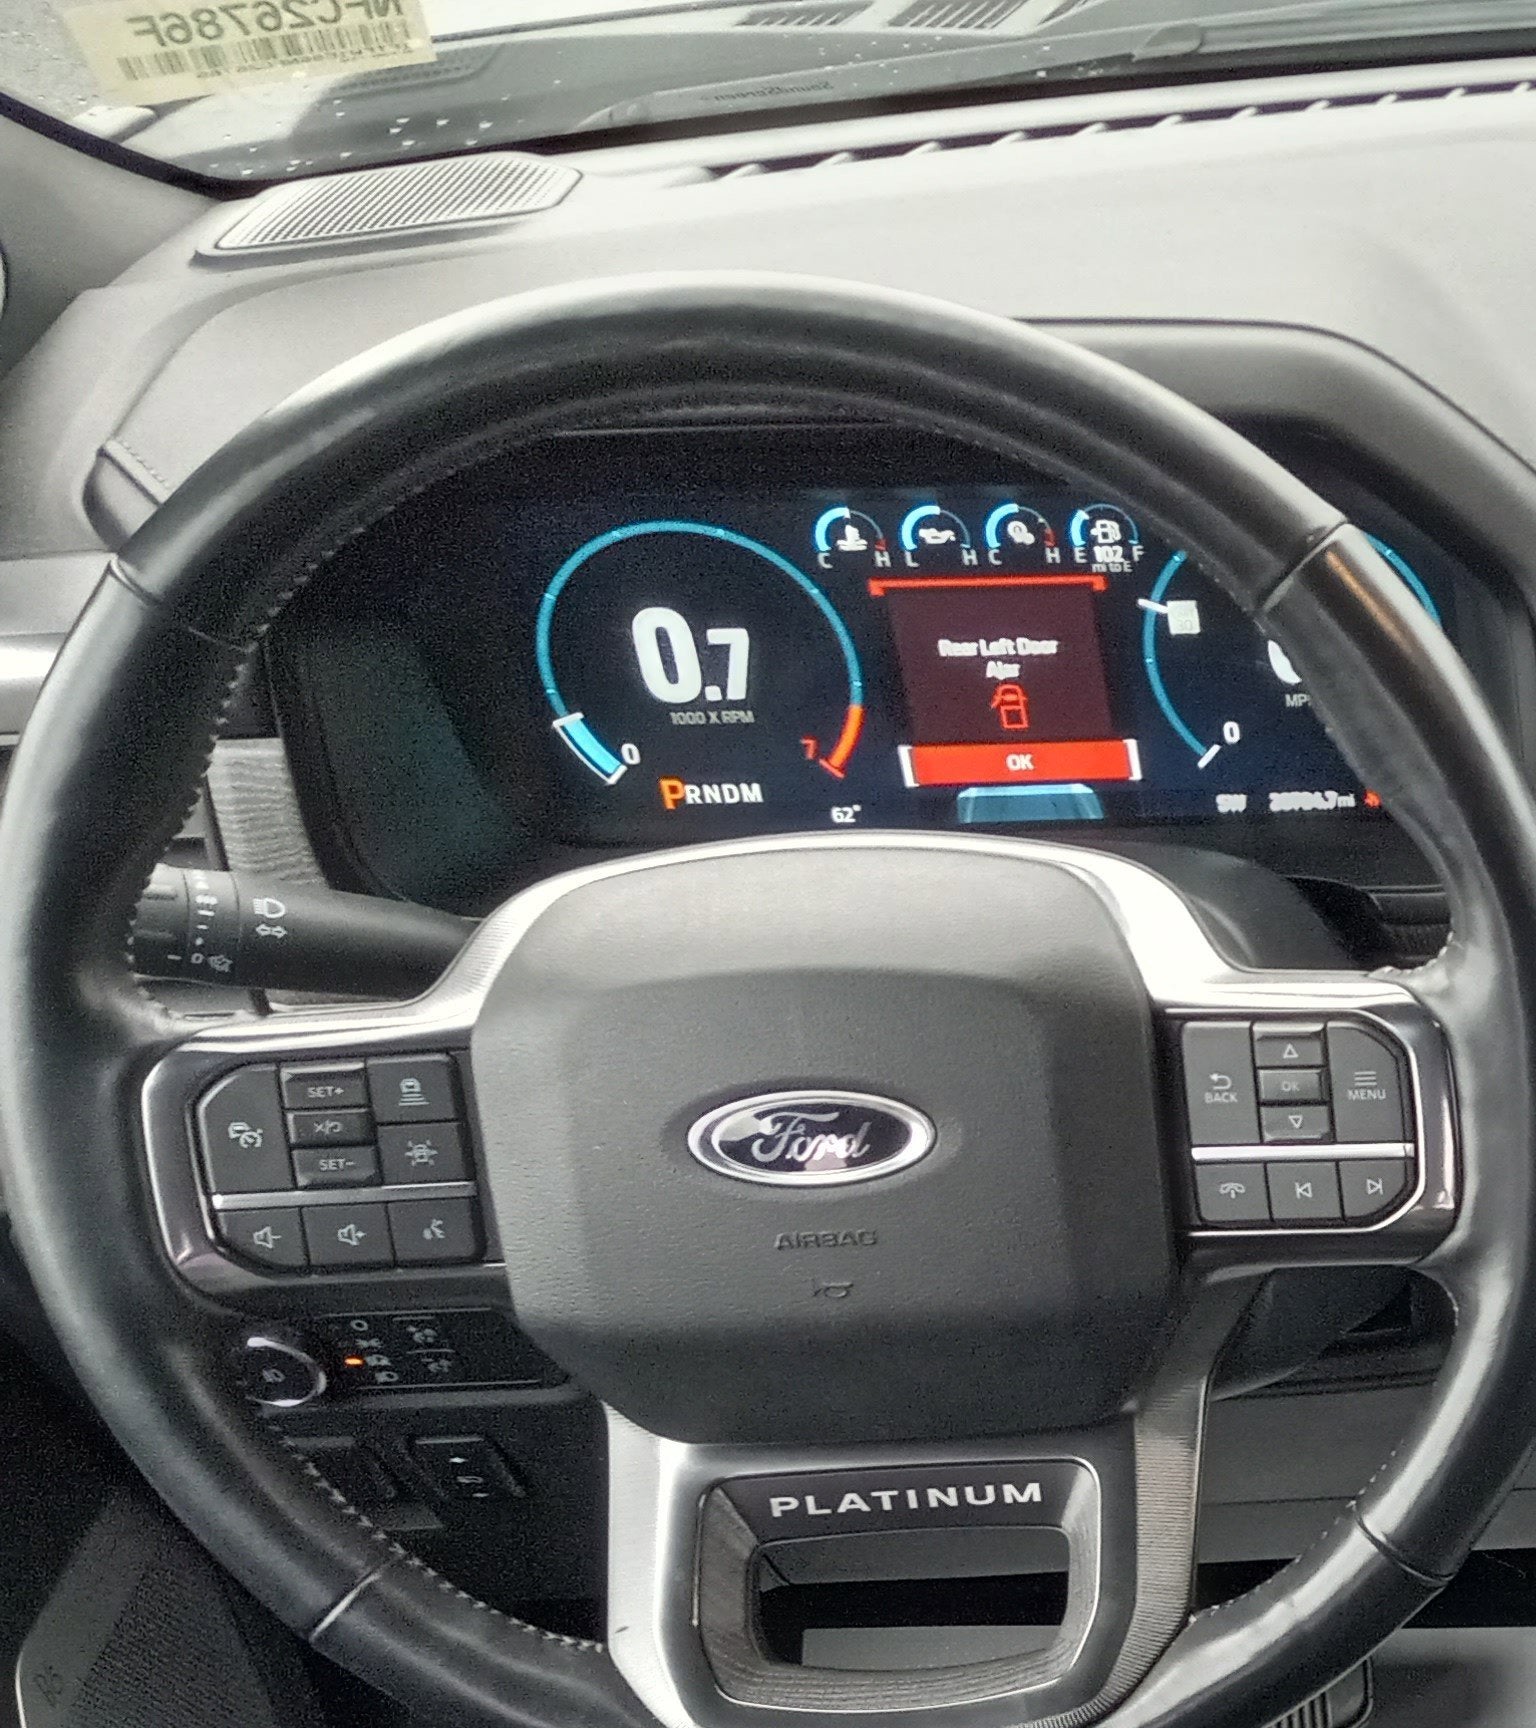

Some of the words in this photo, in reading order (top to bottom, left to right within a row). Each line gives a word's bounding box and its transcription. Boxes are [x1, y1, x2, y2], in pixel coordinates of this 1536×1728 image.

[631, 606, 750, 705] 0.7
[1005, 753, 1035, 771] OK
[1204, 1091, 1238, 1104] BACK
[1348, 1089, 1386, 1101] MENU
[751, 1111, 872, 1163] Ford
[773, 1229, 878, 1251] AIRBAG
[768, 1482, 1043, 1518] PLATINUM
